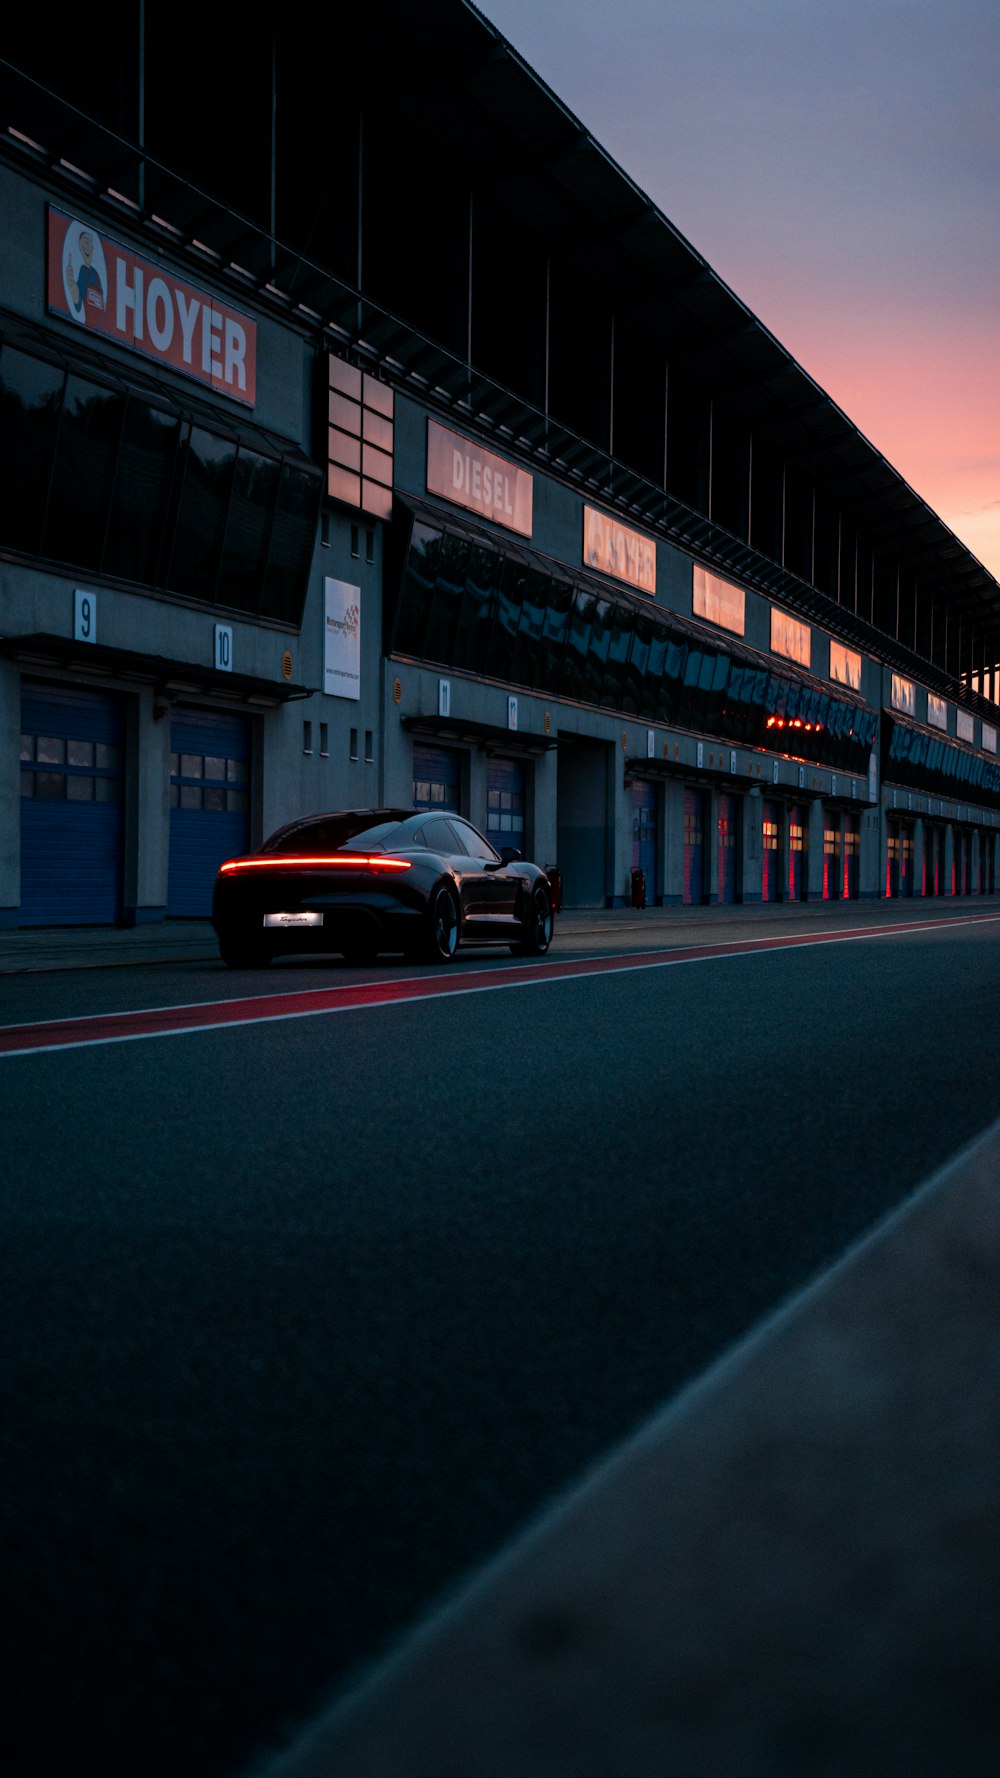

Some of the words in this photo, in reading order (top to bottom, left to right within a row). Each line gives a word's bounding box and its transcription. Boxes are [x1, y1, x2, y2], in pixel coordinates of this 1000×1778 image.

[116, 257, 247, 391] HOYER
[453, 449, 513, 515] DIESEL
[82, 598, 91, 637] 9
[219, 631, 229, 666] 10
